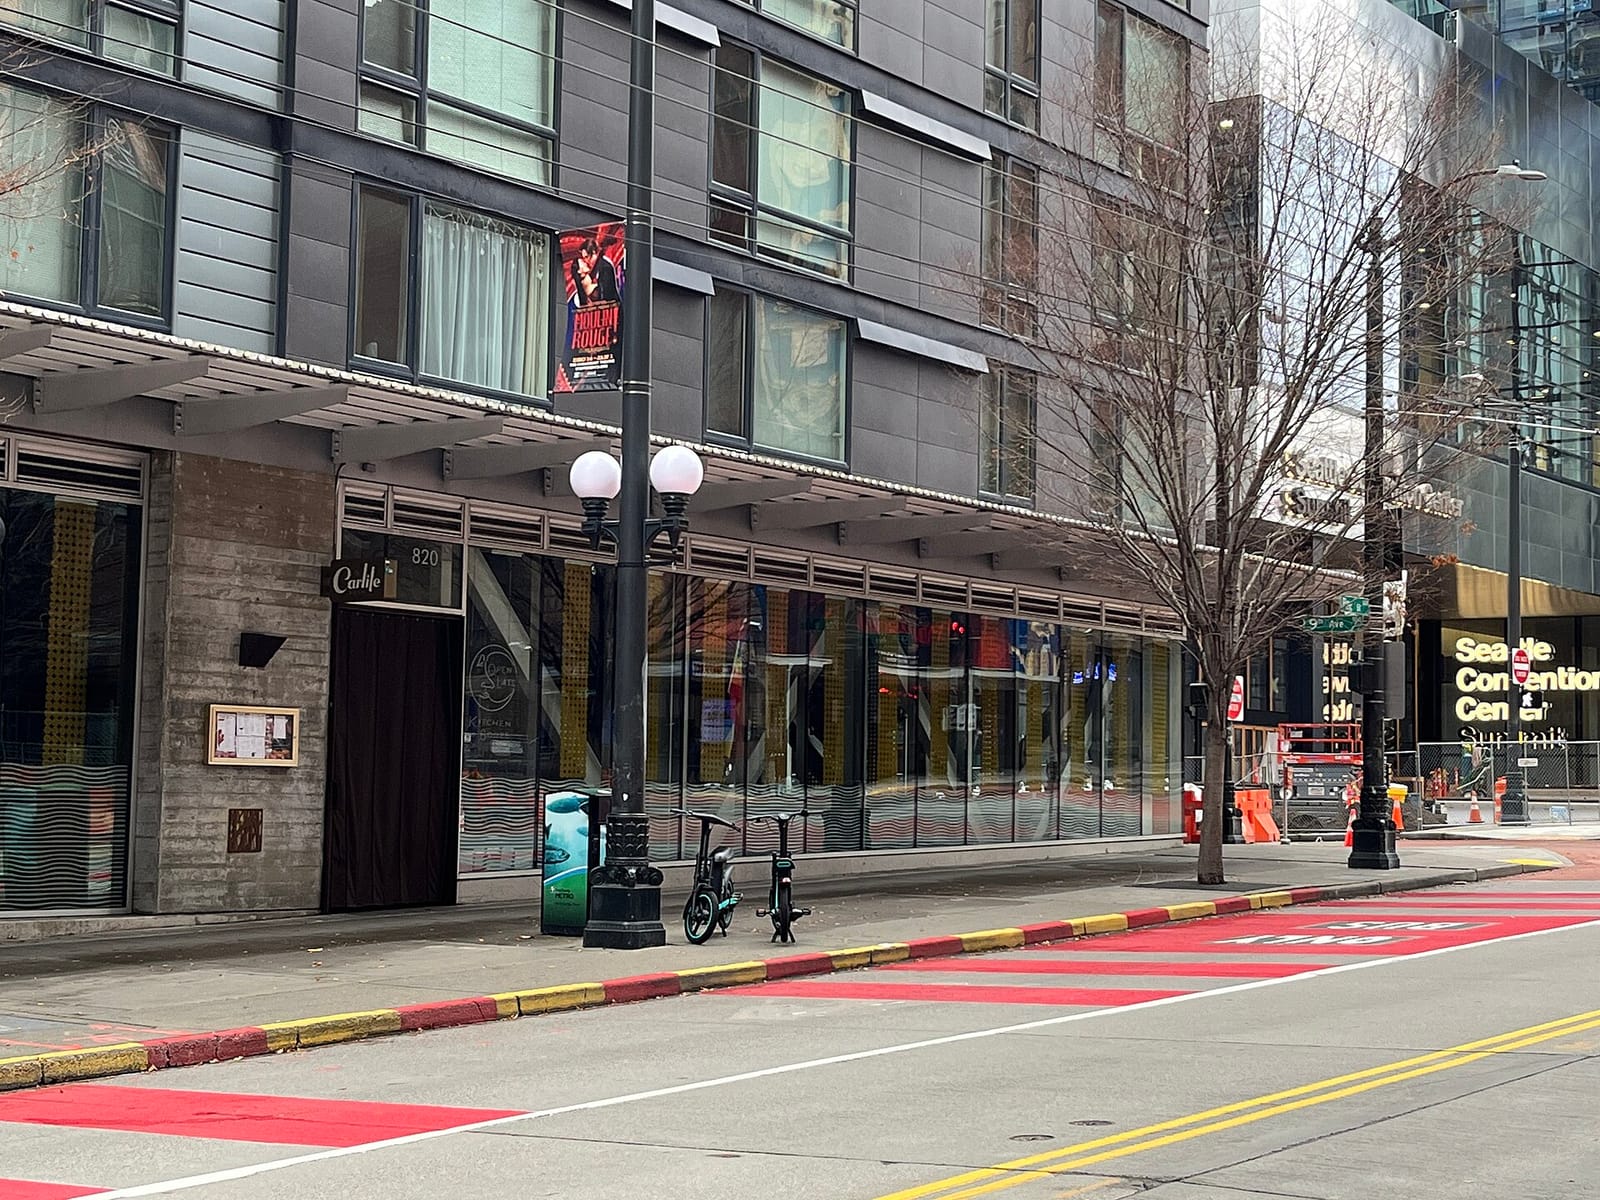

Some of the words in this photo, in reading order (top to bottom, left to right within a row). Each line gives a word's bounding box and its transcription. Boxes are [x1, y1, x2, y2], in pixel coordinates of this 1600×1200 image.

[574, 309, 613, 331] MOULIN
[411, 547, 439, 566] 820
[1455, 696, 1549, 721] Cener
